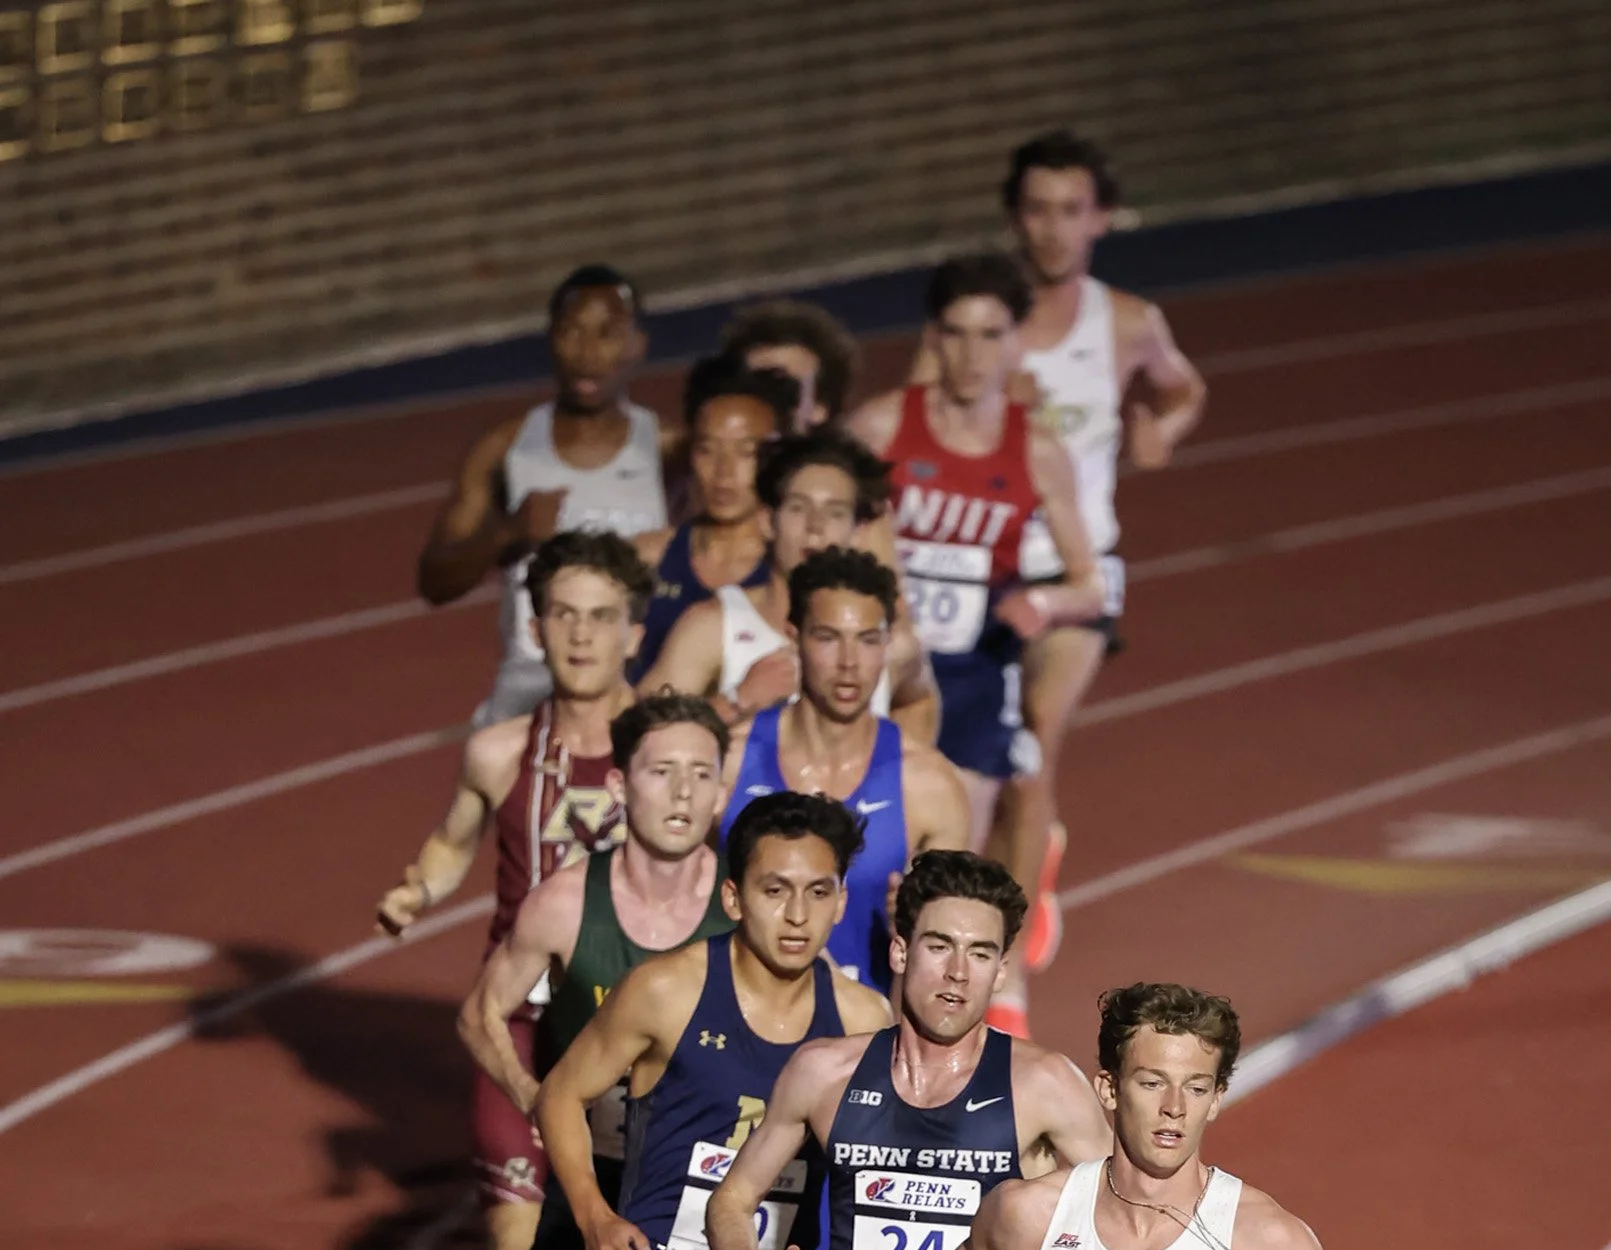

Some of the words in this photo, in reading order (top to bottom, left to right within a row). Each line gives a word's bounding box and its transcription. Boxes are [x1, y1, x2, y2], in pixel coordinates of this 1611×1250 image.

[834, 1142, 911, 1167] PENN
[916, 1149, 1012, 1173] STATE
[905, 1180, 952, 1195] PENN
[902, 1193, 966, 1209] RELAYS
[1053, 1239, 1081, 1248] EAST
